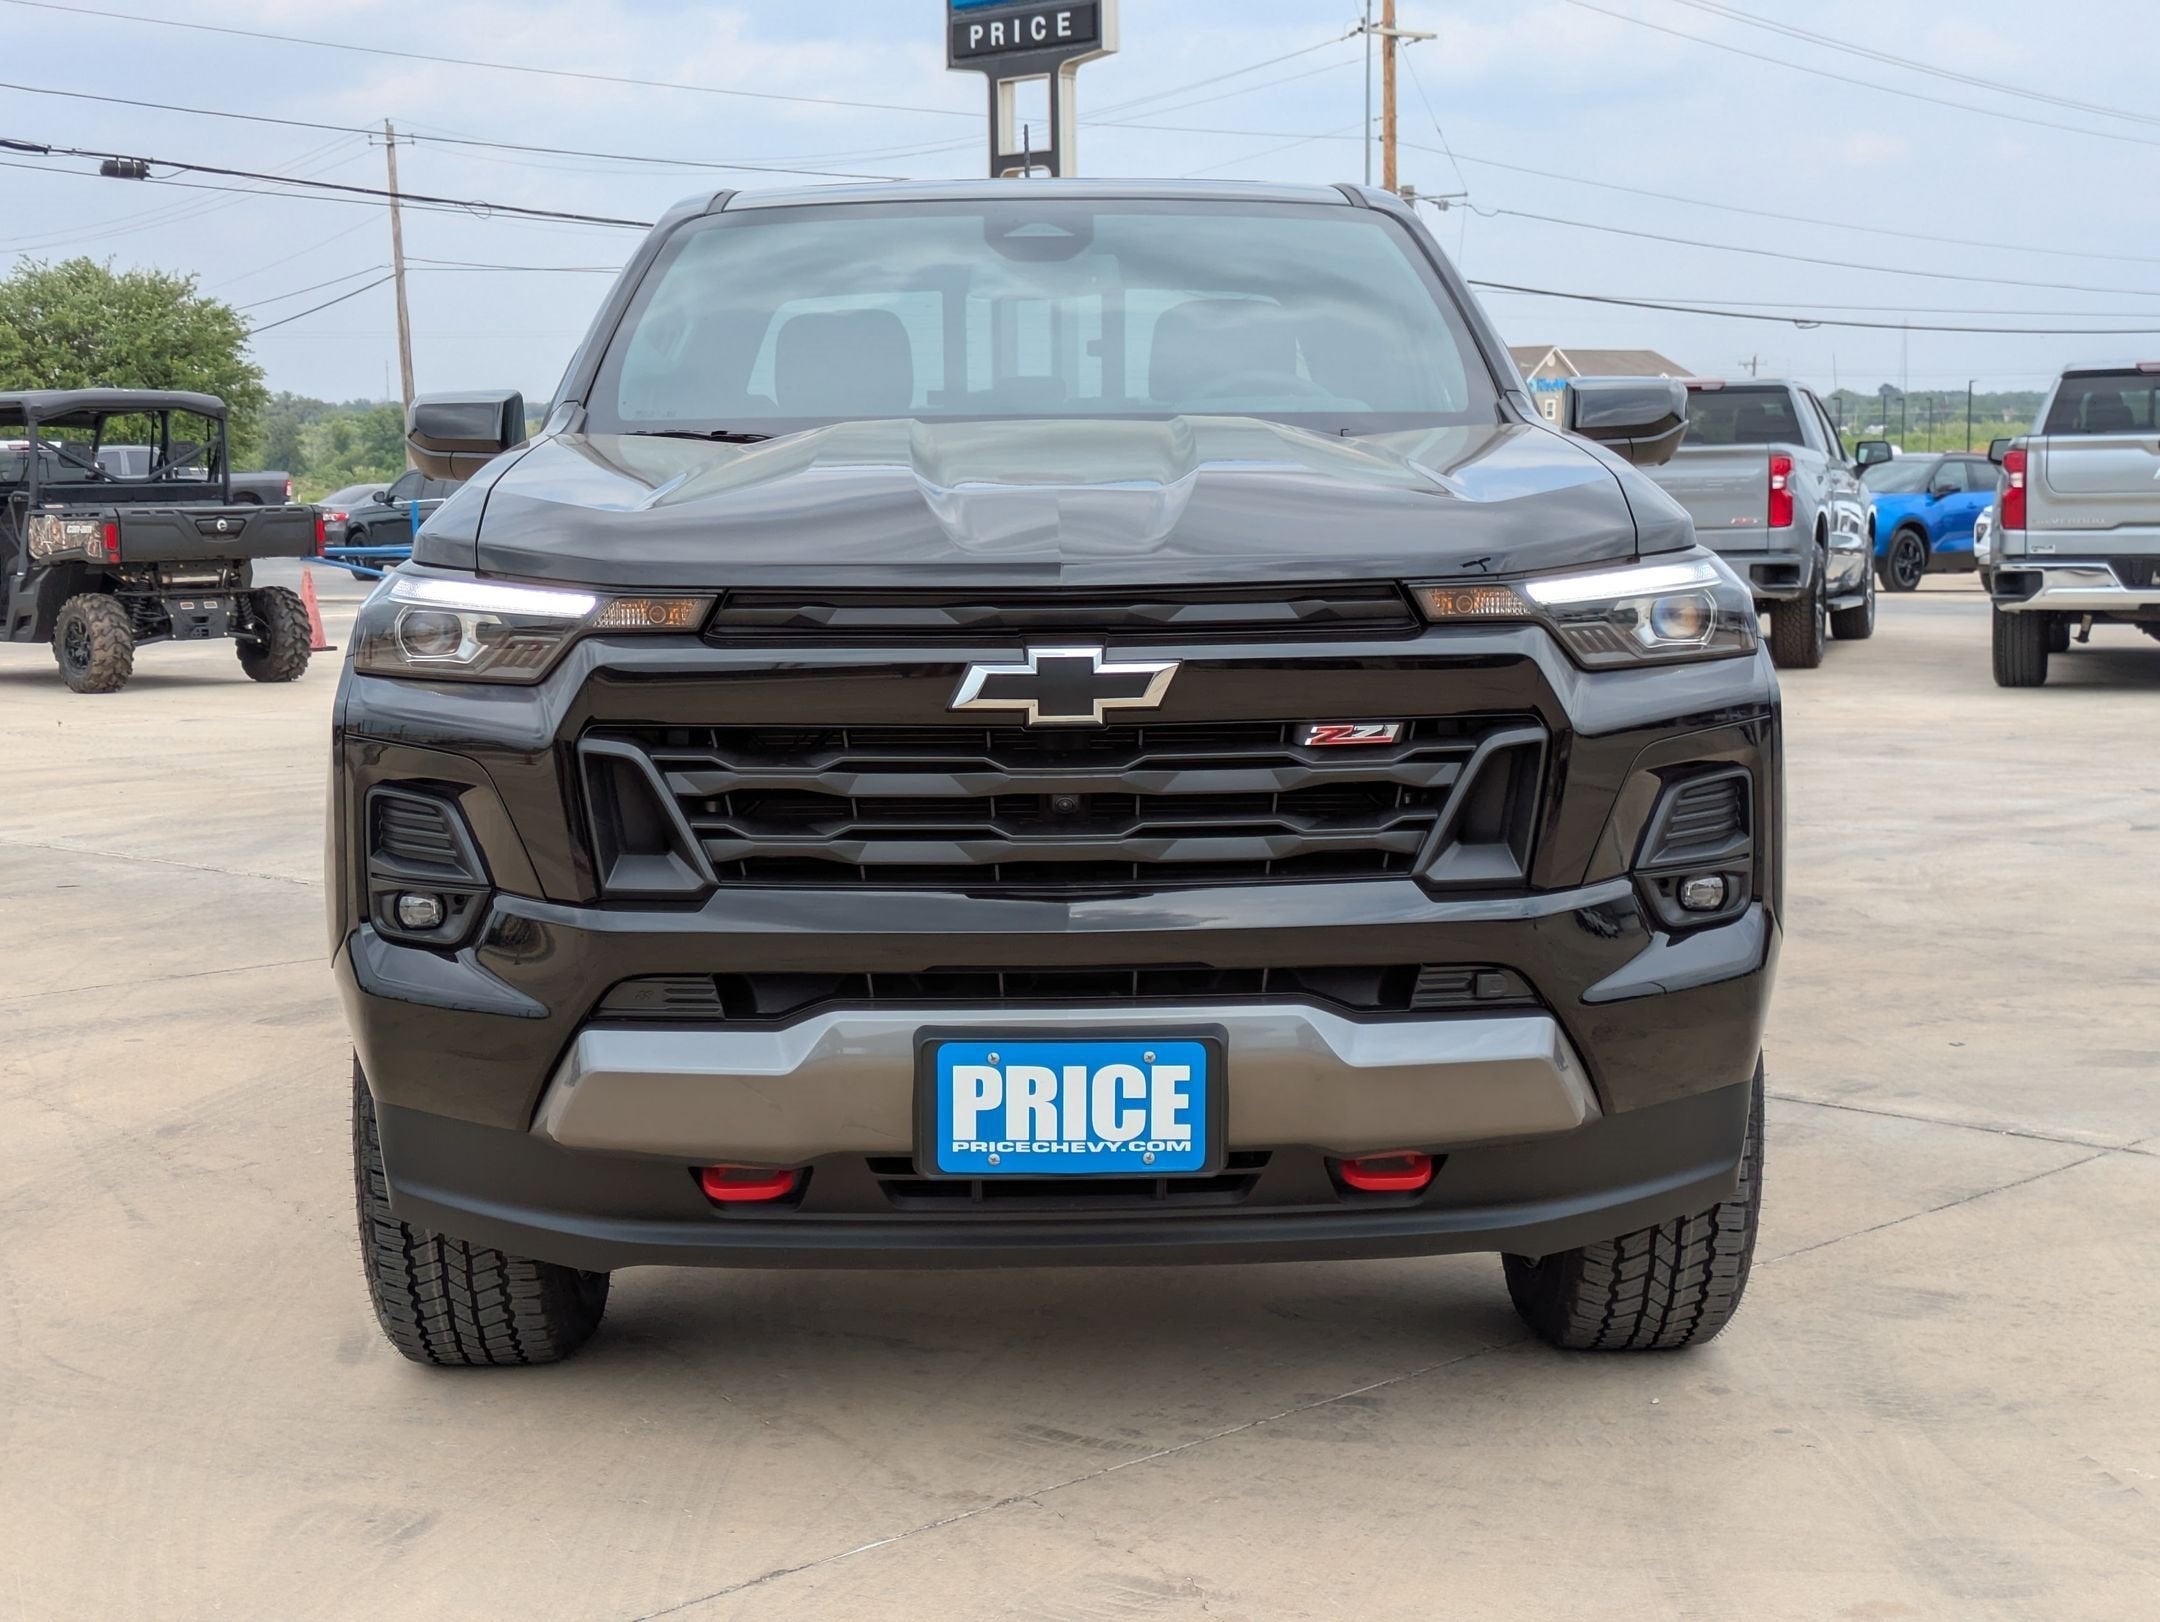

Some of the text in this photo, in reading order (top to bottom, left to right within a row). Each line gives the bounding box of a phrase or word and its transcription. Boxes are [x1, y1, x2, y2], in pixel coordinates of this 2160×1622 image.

[970, 12, 1072, 49] PRICE
[1304, 724, 1400, 746] Z71
[952, 1064, 1191, 1141] PRICE
[952, 1142, 1192, 1154] PRICECHEVY.COM
